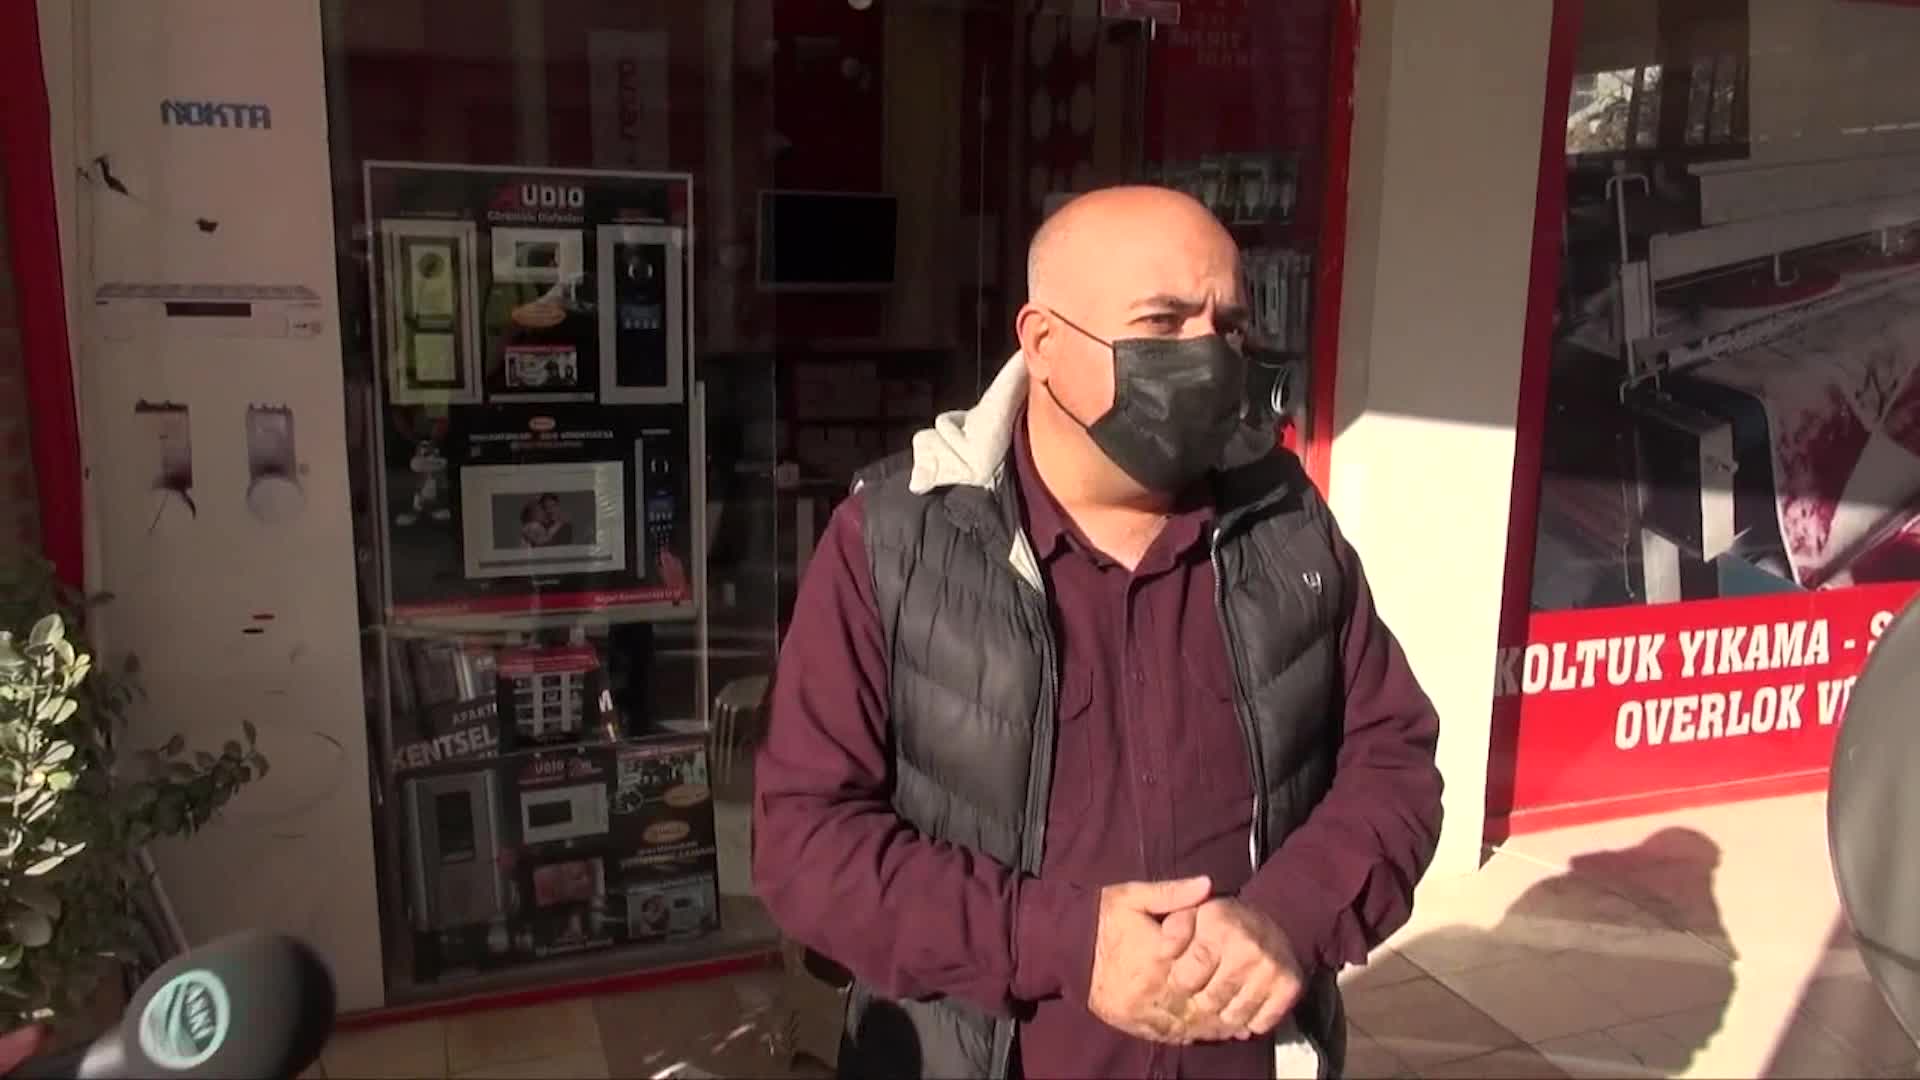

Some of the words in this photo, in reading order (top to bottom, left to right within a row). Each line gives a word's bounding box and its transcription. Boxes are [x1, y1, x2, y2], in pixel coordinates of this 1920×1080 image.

[160, 99, 272, 129] NOKTA
[1494, 633, 1667, 696] KOLTUK
[1679, 618, 1830, 677] YIKAMA
[1614, 683, 1805, 750] OVERLOK
